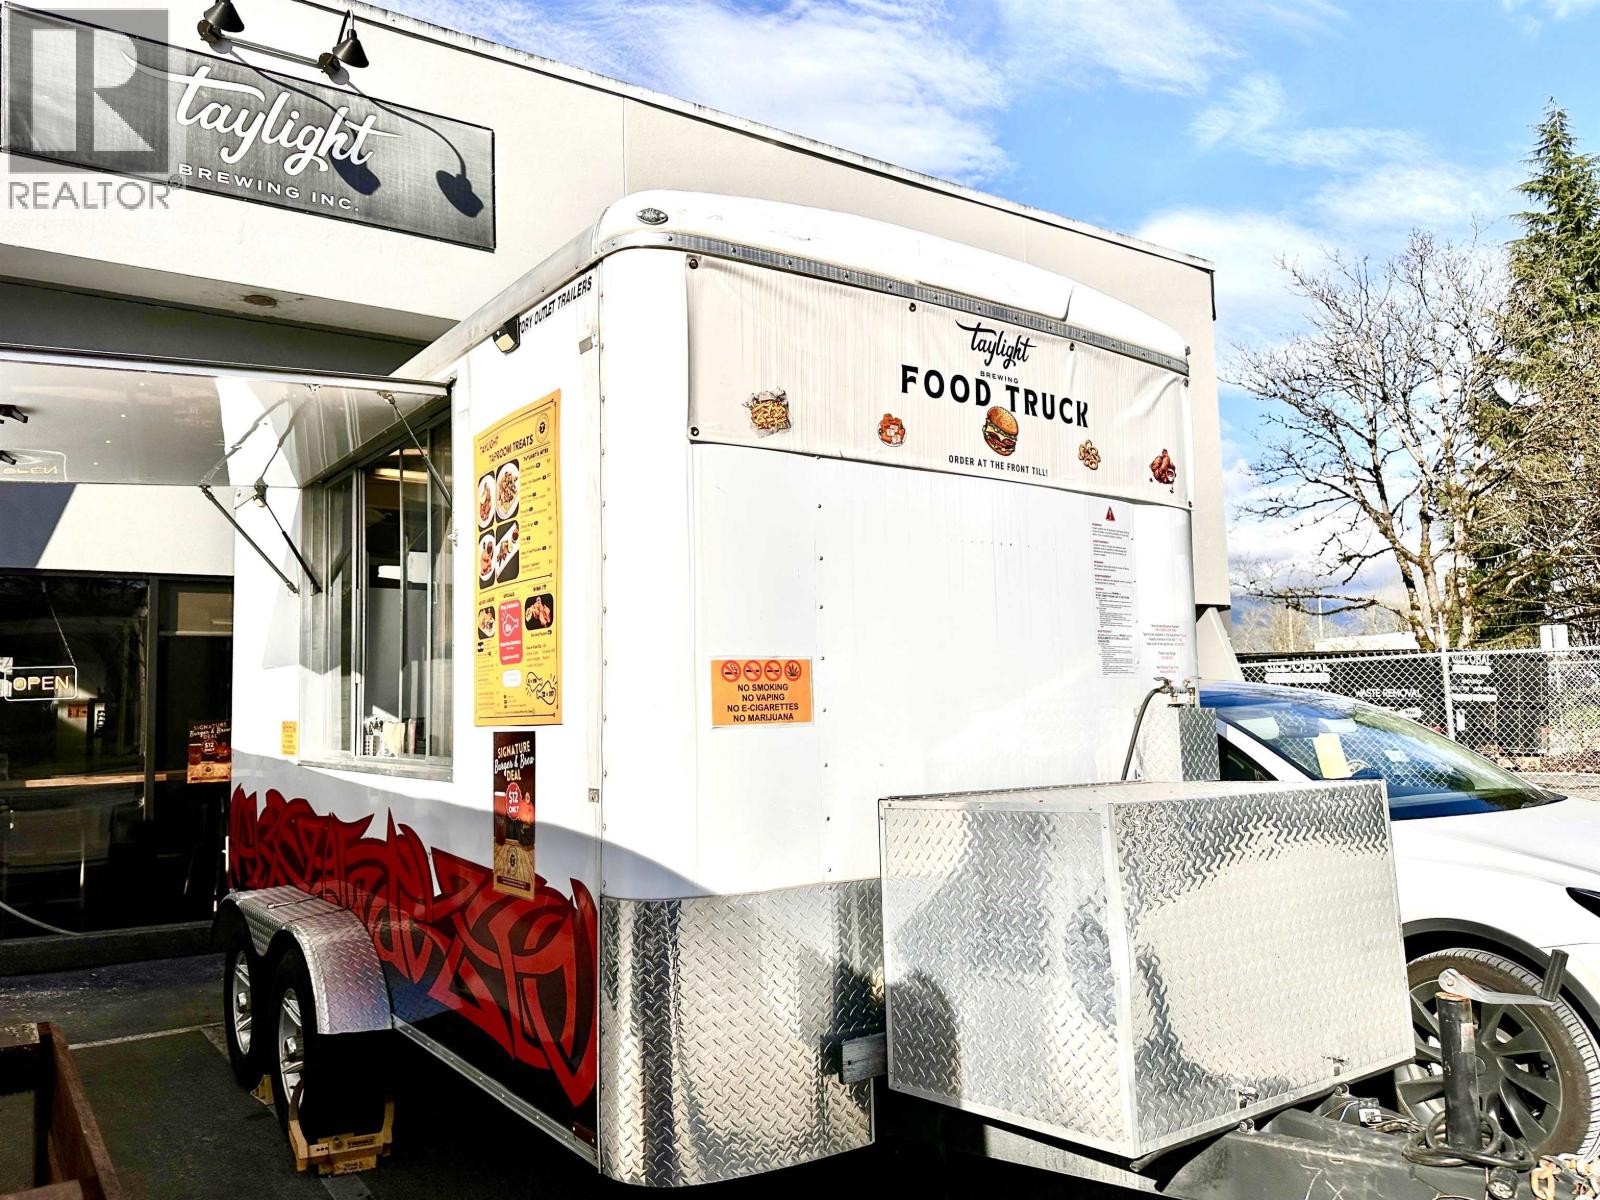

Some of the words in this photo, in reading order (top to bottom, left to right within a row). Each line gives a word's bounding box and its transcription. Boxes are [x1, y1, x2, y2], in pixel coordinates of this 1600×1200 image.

[121, 49, 402, 176] taylight
[178, 163, 301, 200] BREWING
[311, 193, 361, 212] INC.
[519, 314, 534, 334] ORY
[534, 298, 557, 325] OUTLET
[557, 275, 592, 309] TRAILERS
[955, 319, 1038, 370] taylight
[980, 370, 1019, 384] BREWING
[901, 364, 991, 407] FOOD
[1005, 384, 1089, 428] TRUCK
[512, 434, 534, 451] TREATS
[948, 454, 975, 466] ORDER
[977, 458, 987, 468] AT
[990, 460, 1005, 470] THE
[1006, 462, 1030, 474] FRONT
[1032, 465, 1048, 477] TILL!
[12, 675, 70, 691] OPEN
[737, 683, 750, 692] NO
[752, 683, 788, 692] SMOKING
[742, 694, 754, 702] NO
[756, 693, 785, 702] VAPING
[1355, 688, 1381, 698] WASTE
[1383, 688, 1421, 698] REMOVAL
[727, 704, 740, 712] NO
[741, 703, 799, 712] E-CIGARETTES
[733, 714, 746, 722] NO
[748, 713, 794, 722] MARIJUANA
[193, 722, 227, 731] SIGNATURE
[497, 740, 531, 759] SIGNATURE
[494, 759, 514, 777] Burger
[514, 754, 519, 768] &
[520, 753, 535, 769] Brew
[506, 769, 522, 781] DEAL
[508, 791, 519, 804] $12
[508, 805, 520, 813] ONLY
